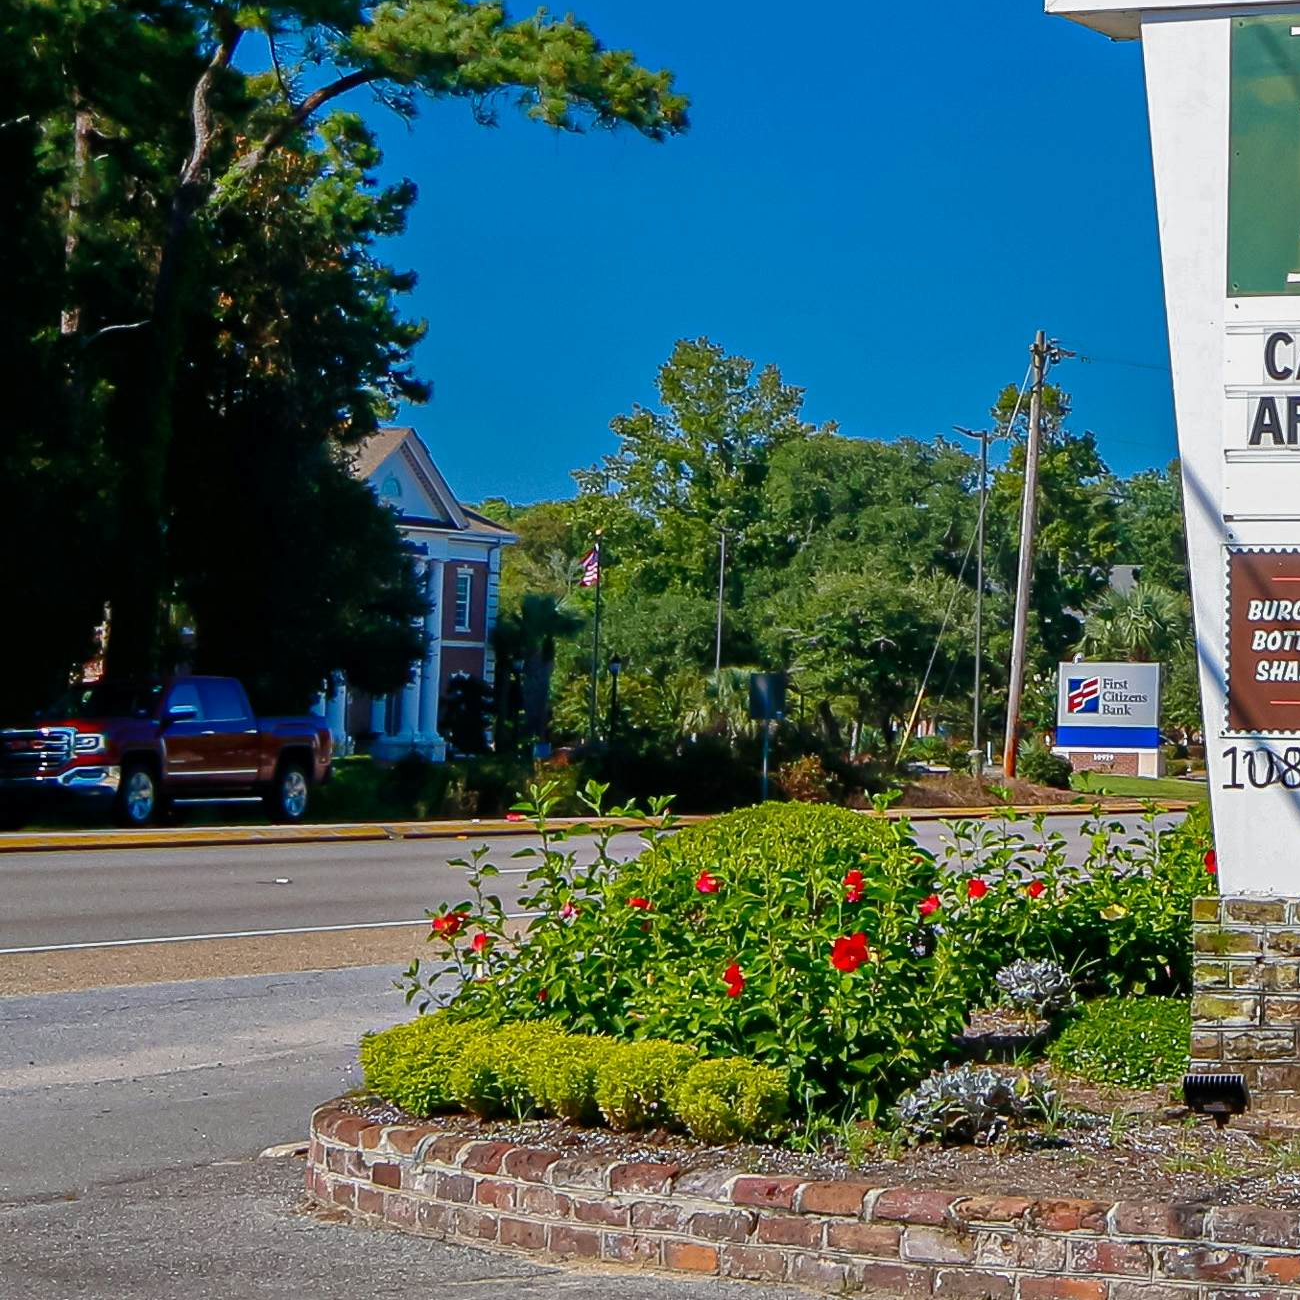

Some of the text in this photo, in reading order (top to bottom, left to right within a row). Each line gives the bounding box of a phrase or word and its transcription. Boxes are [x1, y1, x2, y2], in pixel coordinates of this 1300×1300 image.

[1102, 678, 1128, 690] First
[1102, 691, 1148, 703] Citizens
[1102, 704, 1132, 716] Bank
